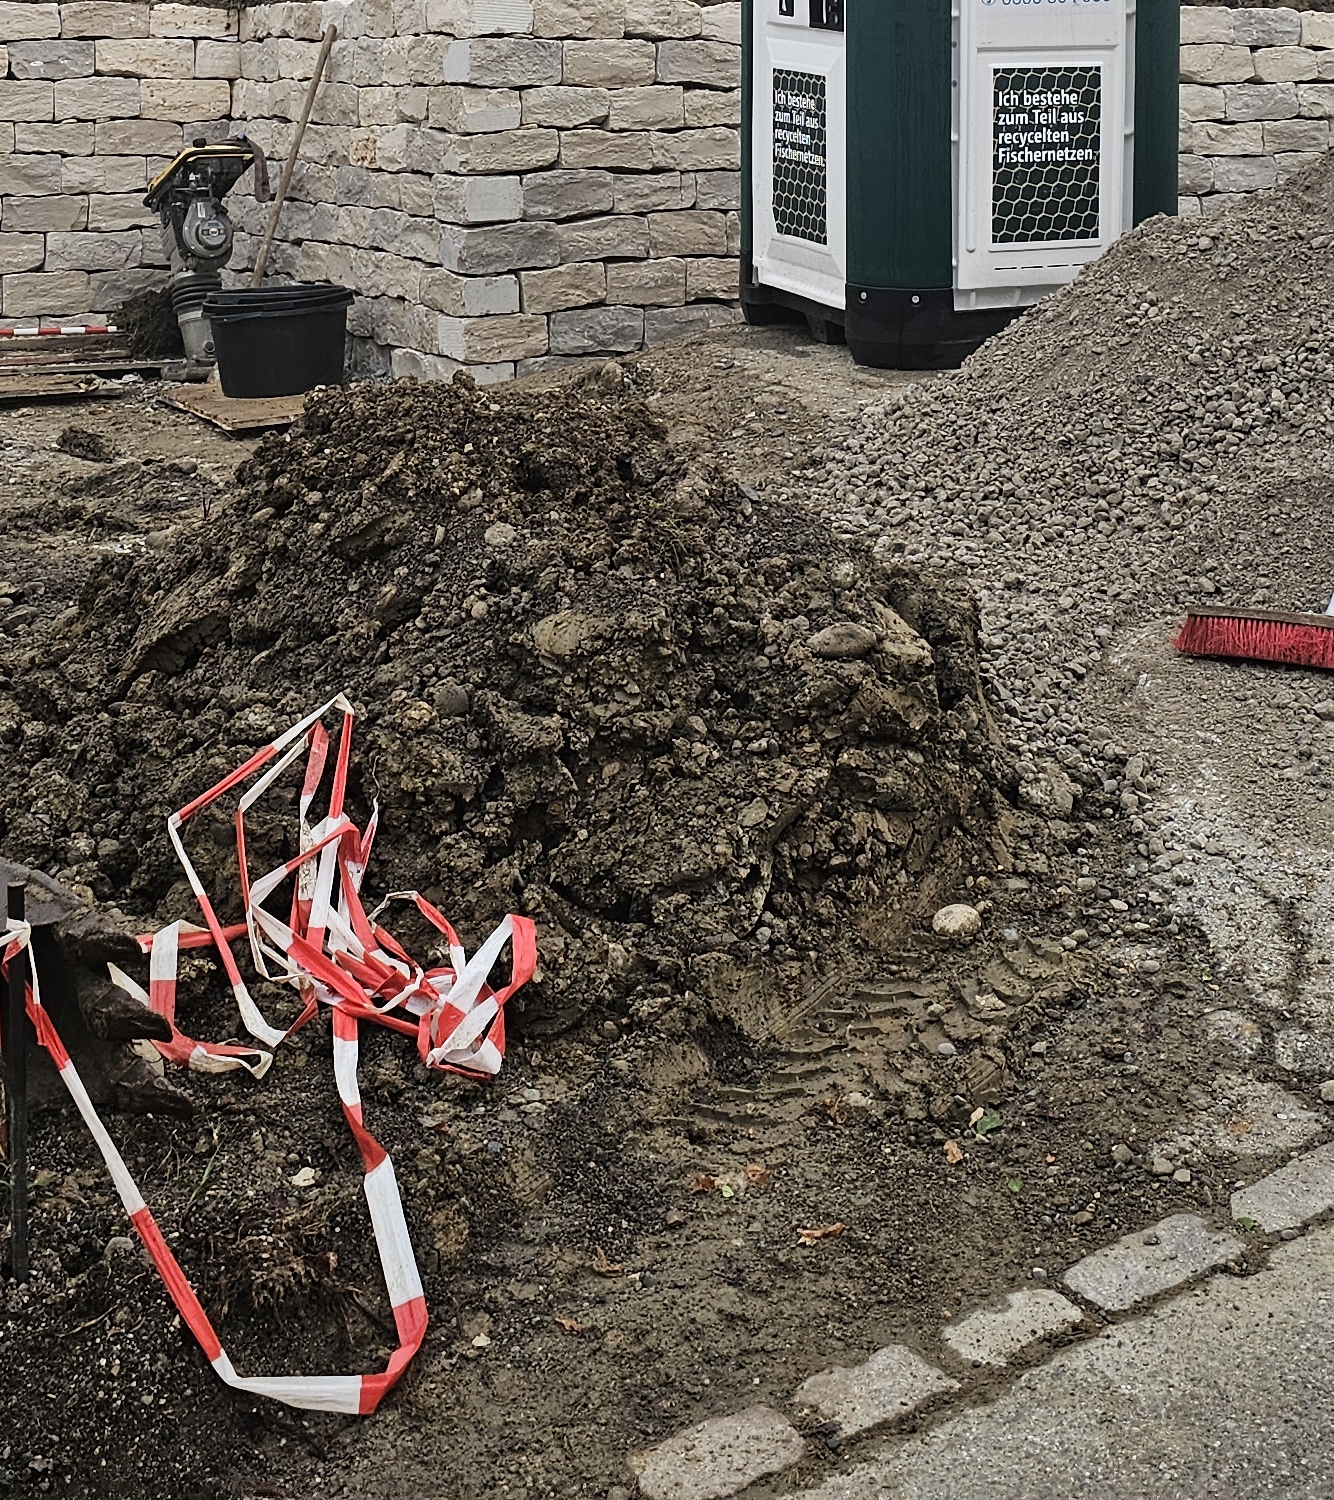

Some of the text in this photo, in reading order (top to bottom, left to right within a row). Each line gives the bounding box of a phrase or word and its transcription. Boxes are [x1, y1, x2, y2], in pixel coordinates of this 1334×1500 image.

[774, 89, 816, 110] Ich bestehe
[998, 88, 1078, 107] Ich bestehe
[774, 109, 819, 129] zum Teil aus
[997, 107, 1085, 126] zum Teil aus
[774, 127, 811, 146] recycelten
[998, 126, 1070, 148] recycelten
[774, 142, 826, 167] Fischernetzen.
[998, 146, 1097, 164] Fischernetzen.
